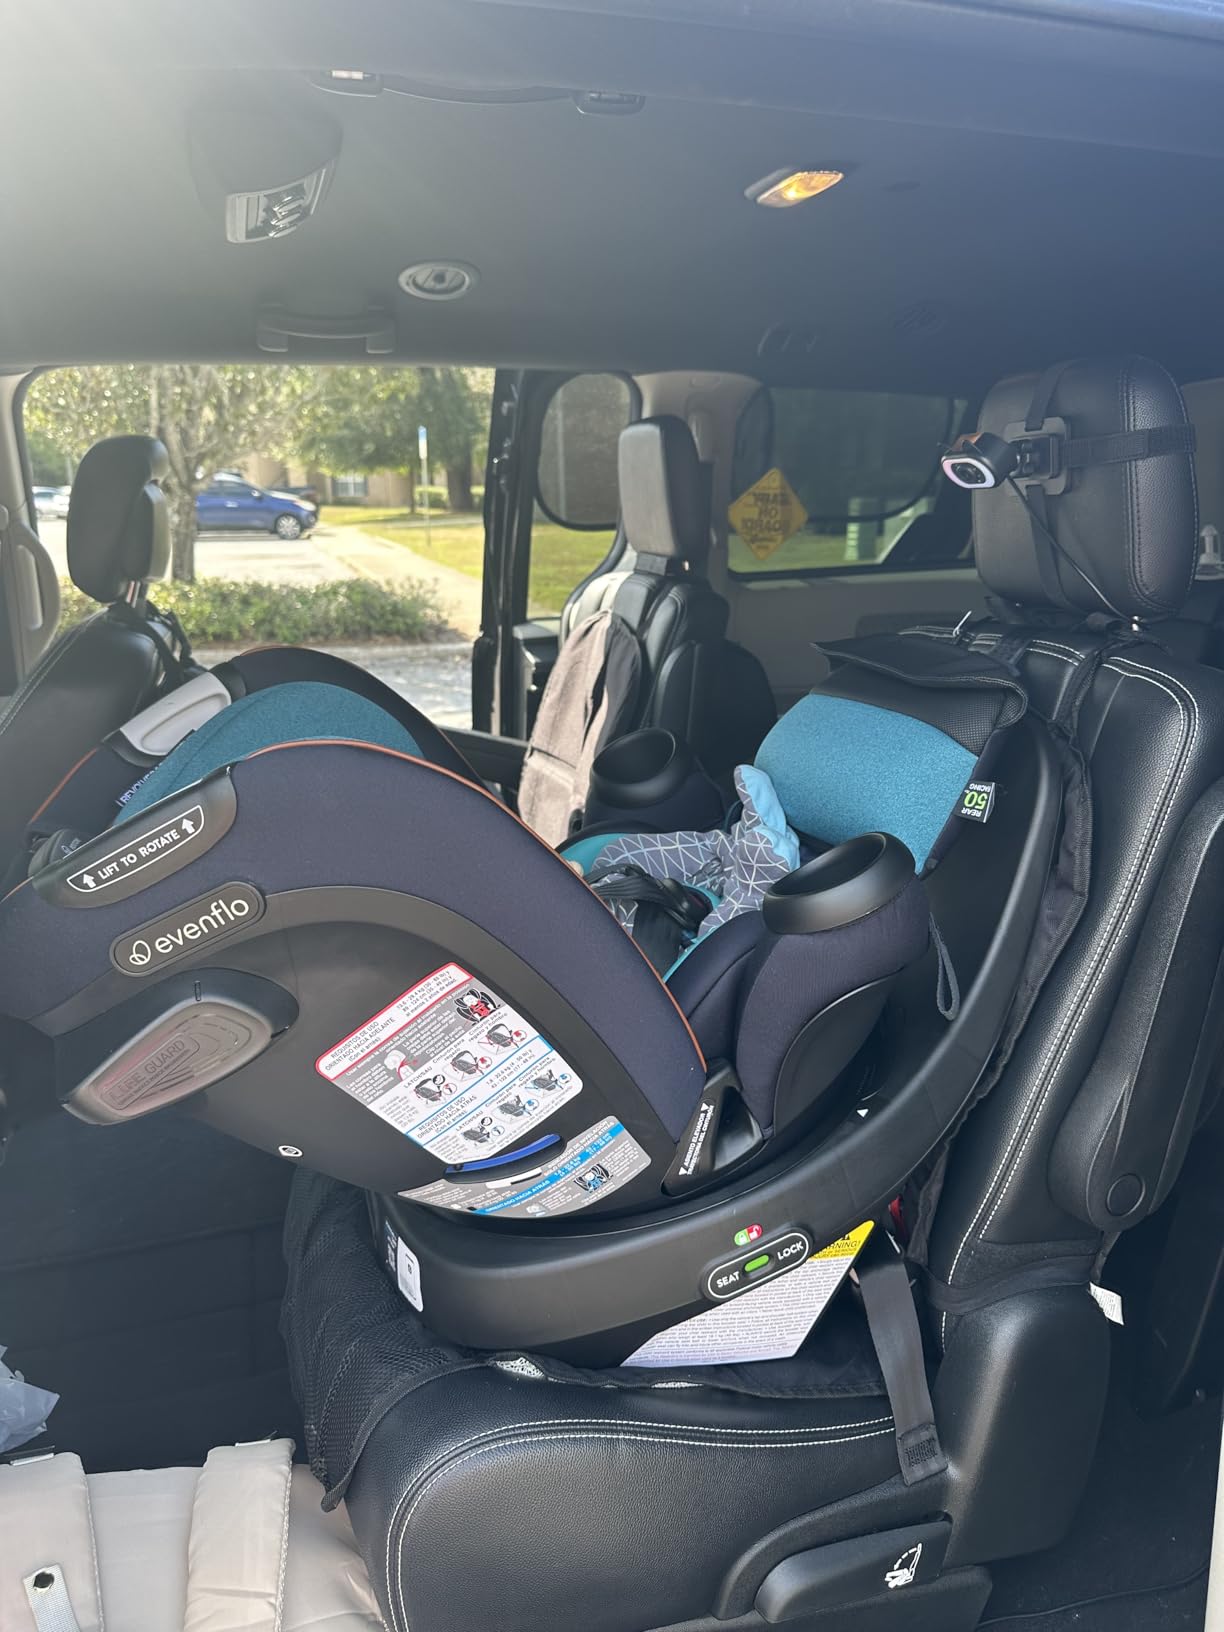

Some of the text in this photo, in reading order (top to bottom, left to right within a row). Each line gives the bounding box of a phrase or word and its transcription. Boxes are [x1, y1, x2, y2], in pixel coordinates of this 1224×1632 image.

[961, 807, 981, 816] REAR
[964, 791, 986, 809] 50
[97, 828, 180, 880] LIFT TO ROTATE
[156, 899, 248, 953] evenflo
[145, 1039, 185, 1074] GUARD
[323, 1017, 396, 1070] ORIENTADO HACIA ADELANTE
[329, 1020, 380, 1058] REQUISITOS DE USO
[715, 1240, 804, 1287] SEAT LOCK
